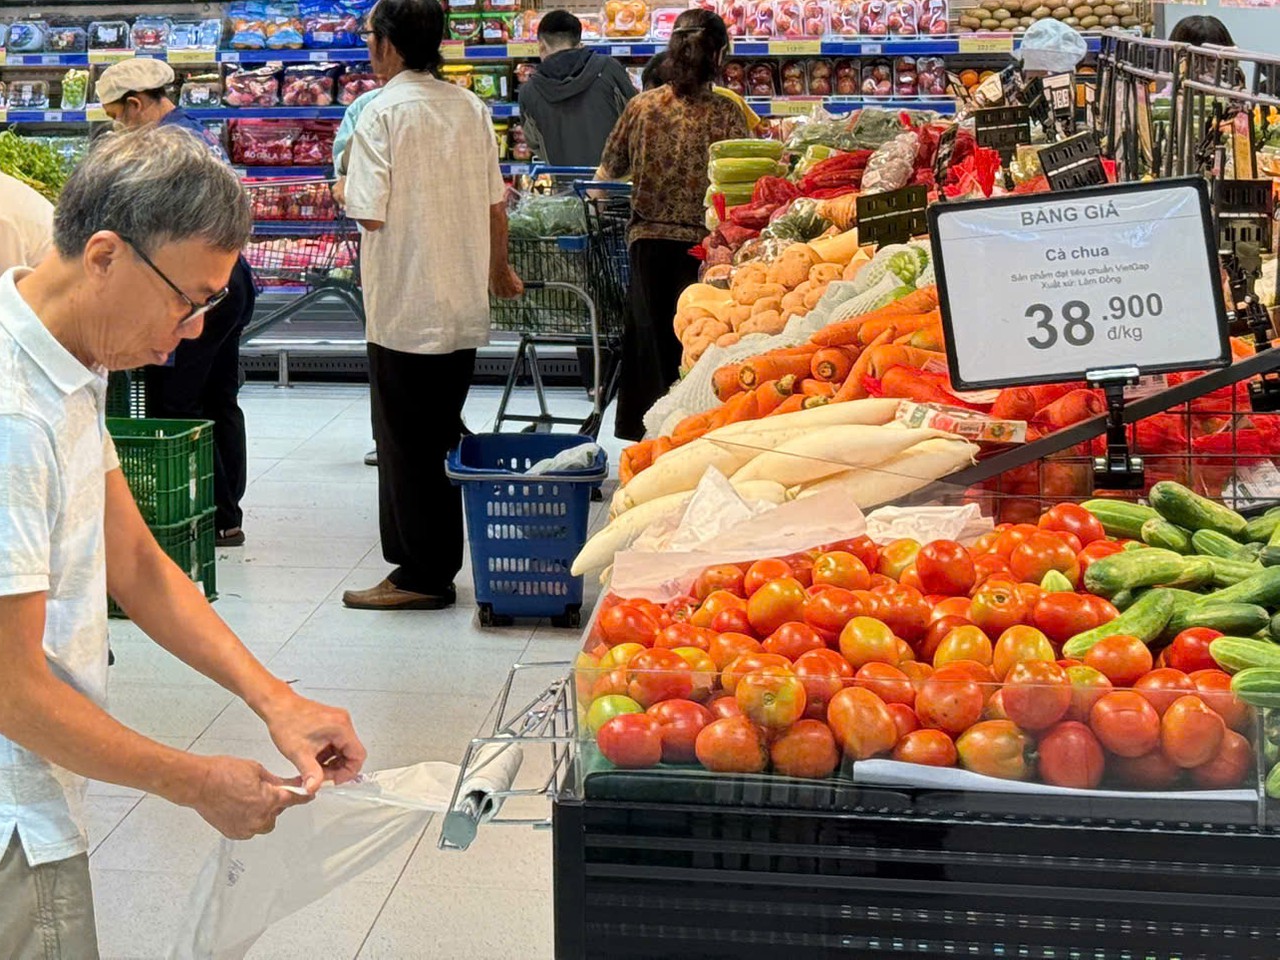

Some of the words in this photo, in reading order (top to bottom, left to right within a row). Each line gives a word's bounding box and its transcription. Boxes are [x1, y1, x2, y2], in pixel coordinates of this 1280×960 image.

[1020, 204, 1079, 228] BẢNG
[1084, 199, 1120, 221] GIÁ
[1045, 247, 1067, 262] Cà
[1070, 244, 1110, 260] chua
[1023, 299, 1096, 350] 38
[1101, 292, 1164, 322] .900
[1106, 323, 1144, 342] đ/kg
